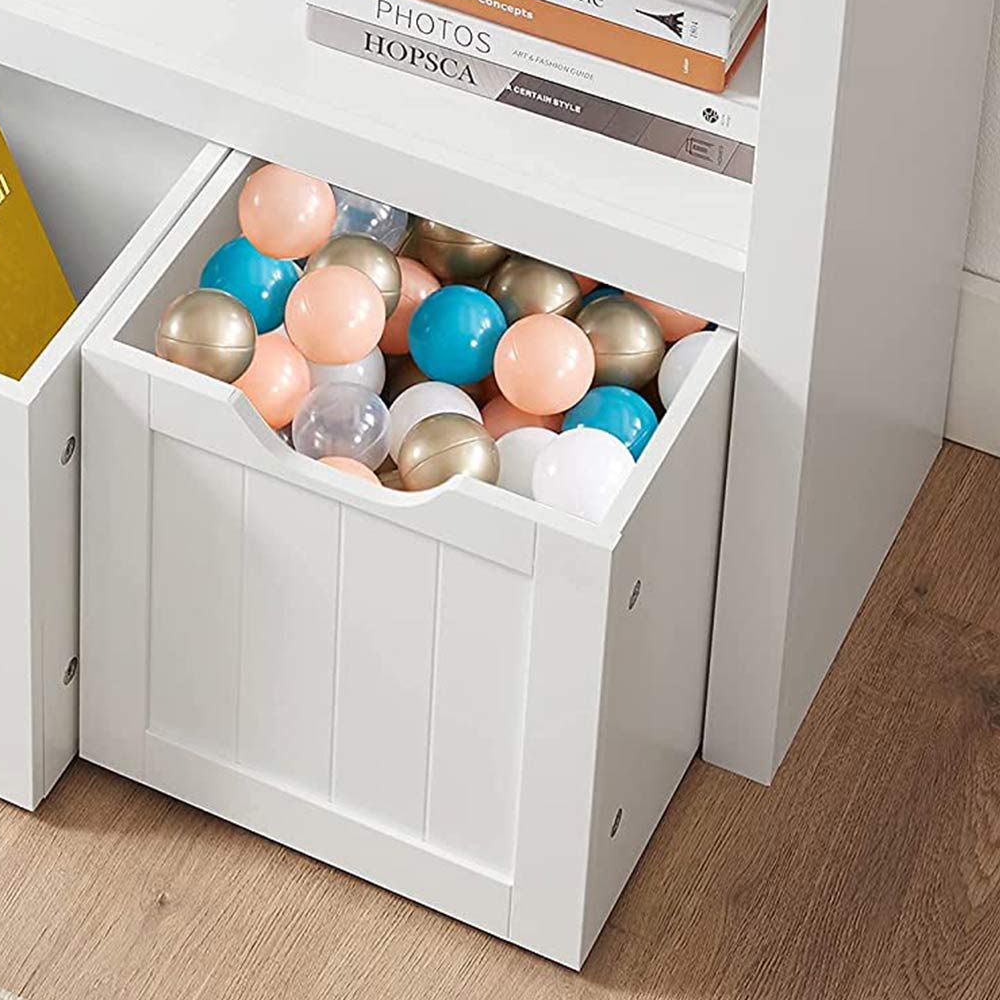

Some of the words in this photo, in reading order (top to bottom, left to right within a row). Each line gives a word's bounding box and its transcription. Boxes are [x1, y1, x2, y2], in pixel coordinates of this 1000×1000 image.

[364, 31, 477, 86] HOPSCA
[534, 56, 569, 74] FASHION
[569, 67, 594, 81] GUIDE
[513, 85, 552, 104] CERTAIN
[552, 98, 583, 114] STYLE
